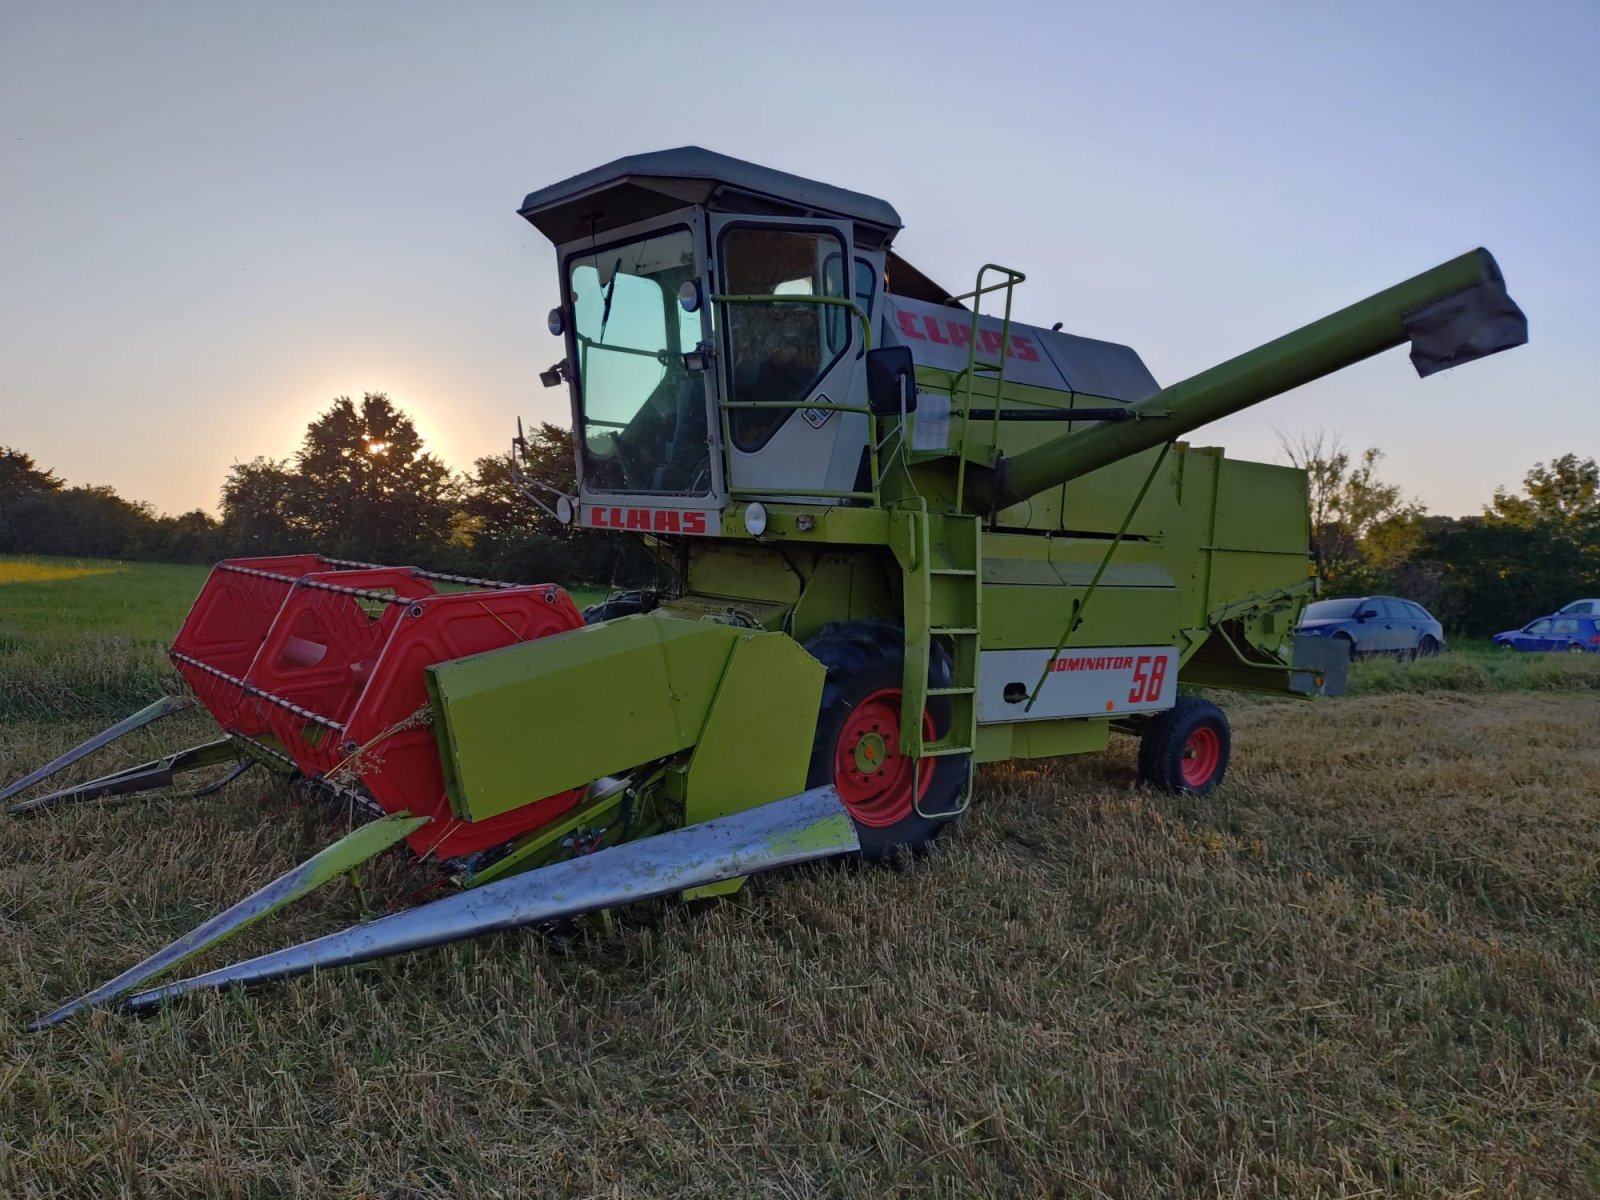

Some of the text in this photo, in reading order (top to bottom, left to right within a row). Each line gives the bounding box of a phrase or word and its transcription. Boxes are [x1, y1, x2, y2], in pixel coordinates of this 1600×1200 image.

[896, 310, 1040, 362] CLAAS
[591, 507, 706, 534] CLAAS
[1128, 655, 1168, 703] 58
